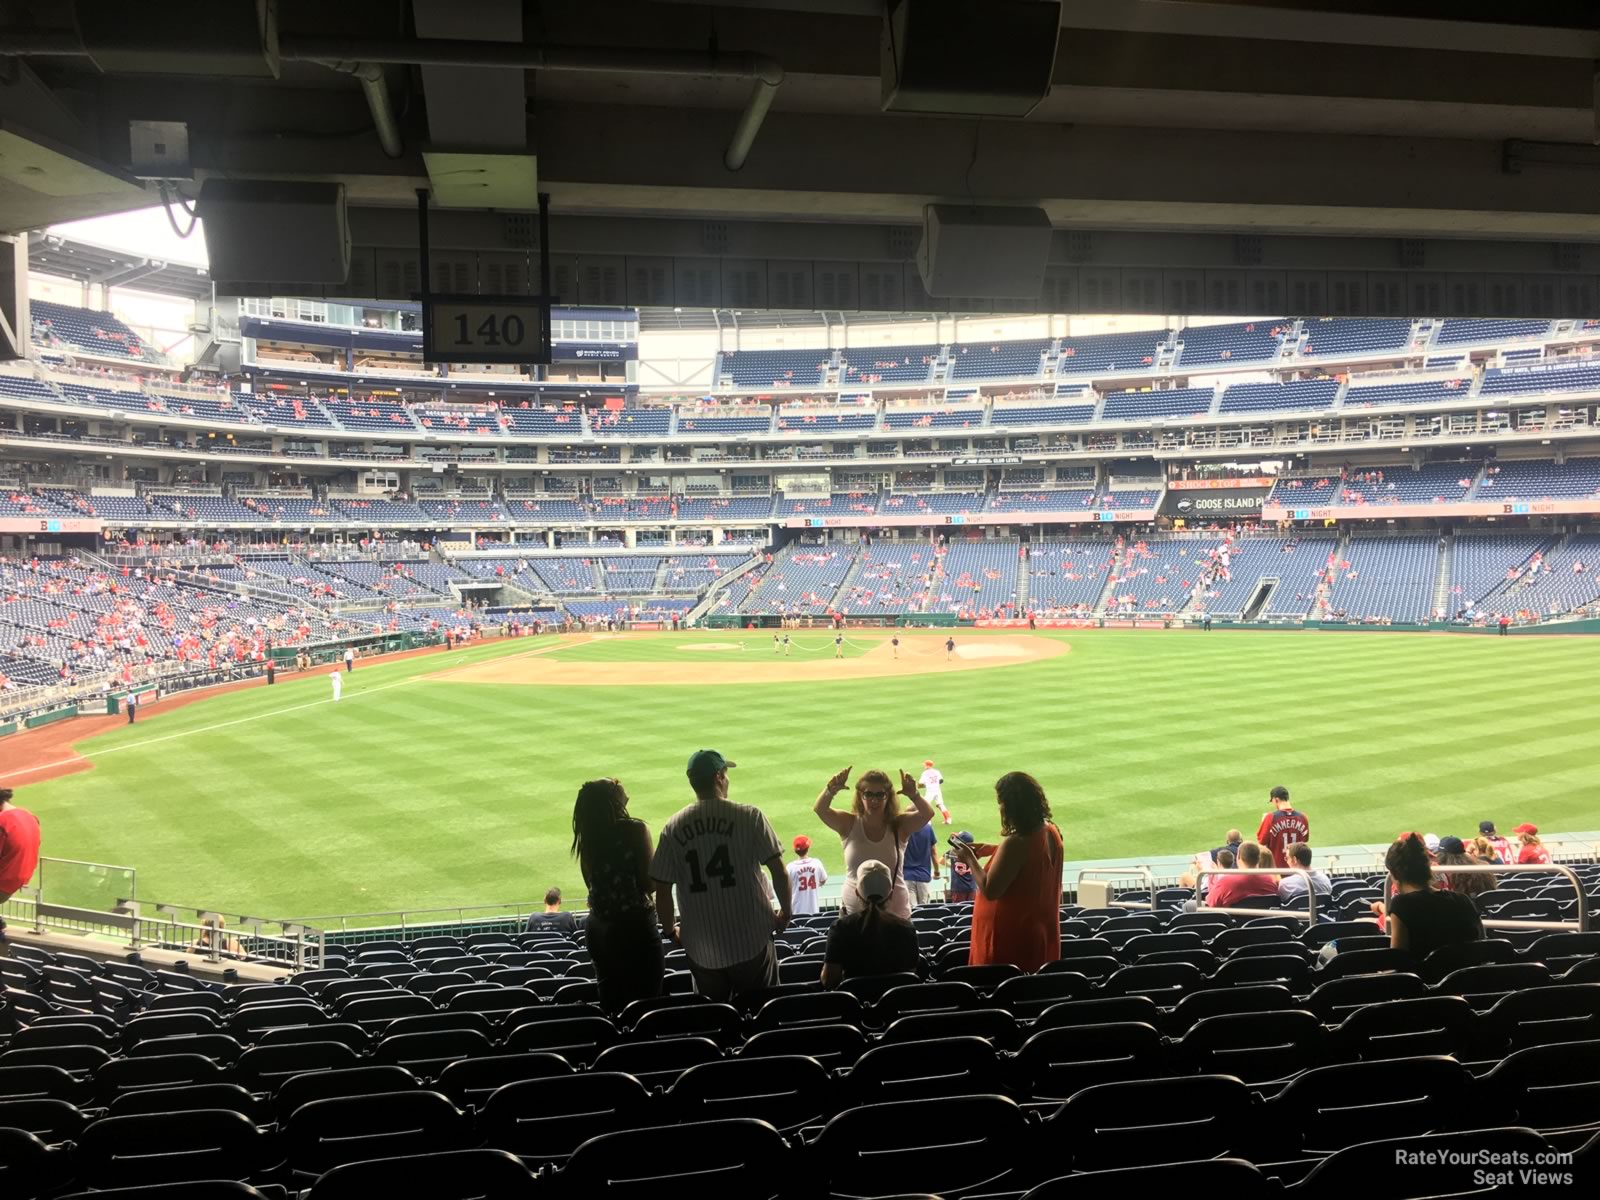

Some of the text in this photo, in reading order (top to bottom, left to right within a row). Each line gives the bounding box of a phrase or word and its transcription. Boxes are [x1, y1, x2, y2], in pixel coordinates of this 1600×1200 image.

[454, 314, 525, 346] 140
[1179, 480, 1211, 489] SHOCK
[1217, 479, 1237, 488] TOP
[1196, 499, 1223, 509] GOOSE
[1224, 498, 1254, 508] ISLAND
[1532, 503, 1555, 512] NIGHT
[1311, 510, 1331, 518] NIGHT
[112, 530, 127, 539] PNC
[383, 530, 399, 538] PNC
[685, 844, 737, 893] 14
[799, 875, 816, 891] 34
